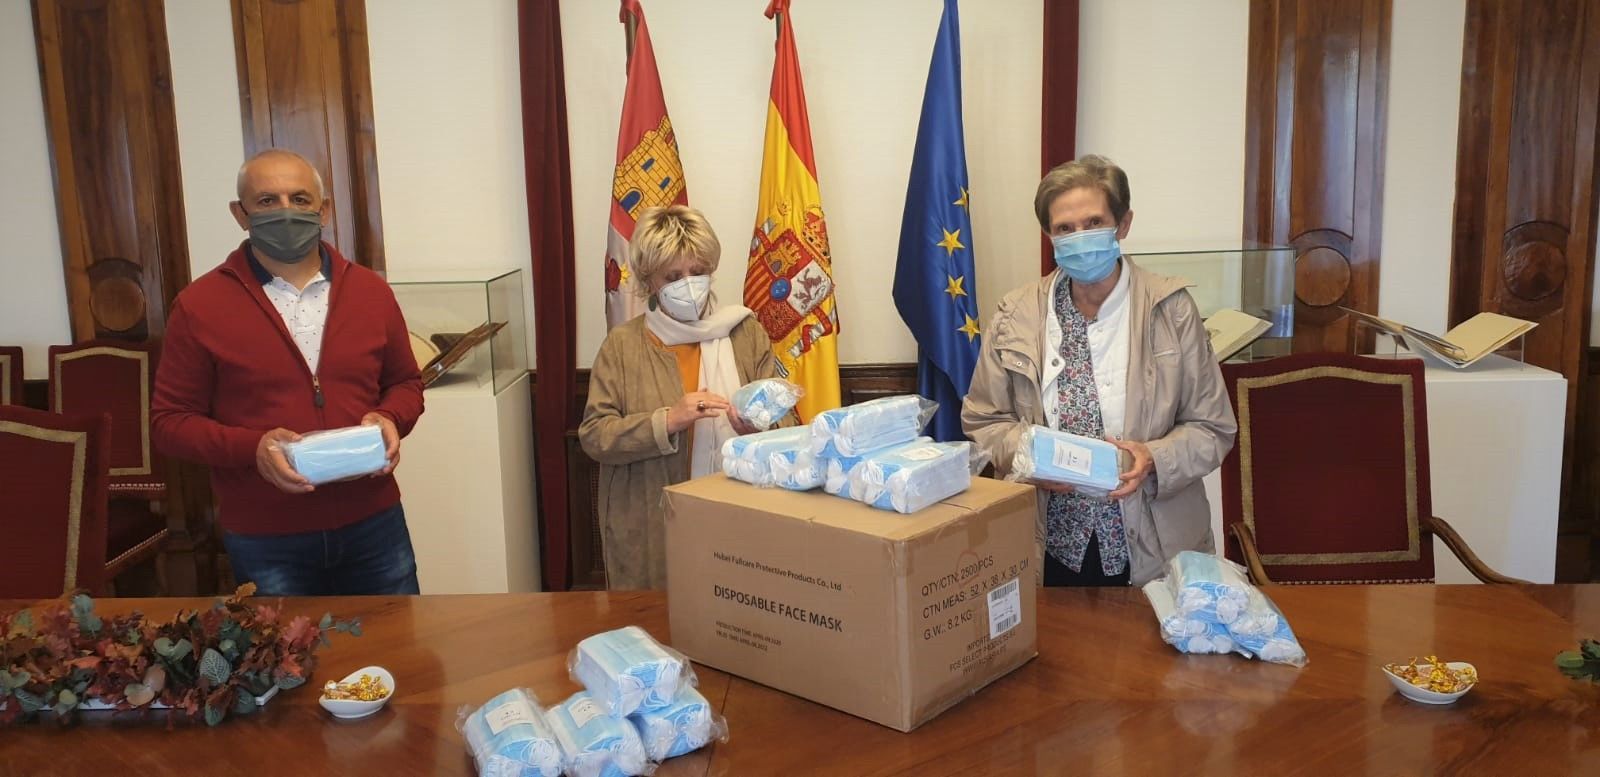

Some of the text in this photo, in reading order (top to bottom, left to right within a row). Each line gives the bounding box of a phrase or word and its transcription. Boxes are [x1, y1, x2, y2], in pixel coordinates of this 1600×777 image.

[714, 551, 731, 563] Hubei
[755, 562, 787, 577] Protective
[787, 570, 816, 585] Products
[830, 581, 842, 591] Ltd
[714, 584, 843, 632] DISPOSABLE FACE MASK
[923, 602, 941, 619] CTN
[970, 584, 980, 597] 52
[982, 580, 988, 591] X
[960, 609, 973, 624] KG
